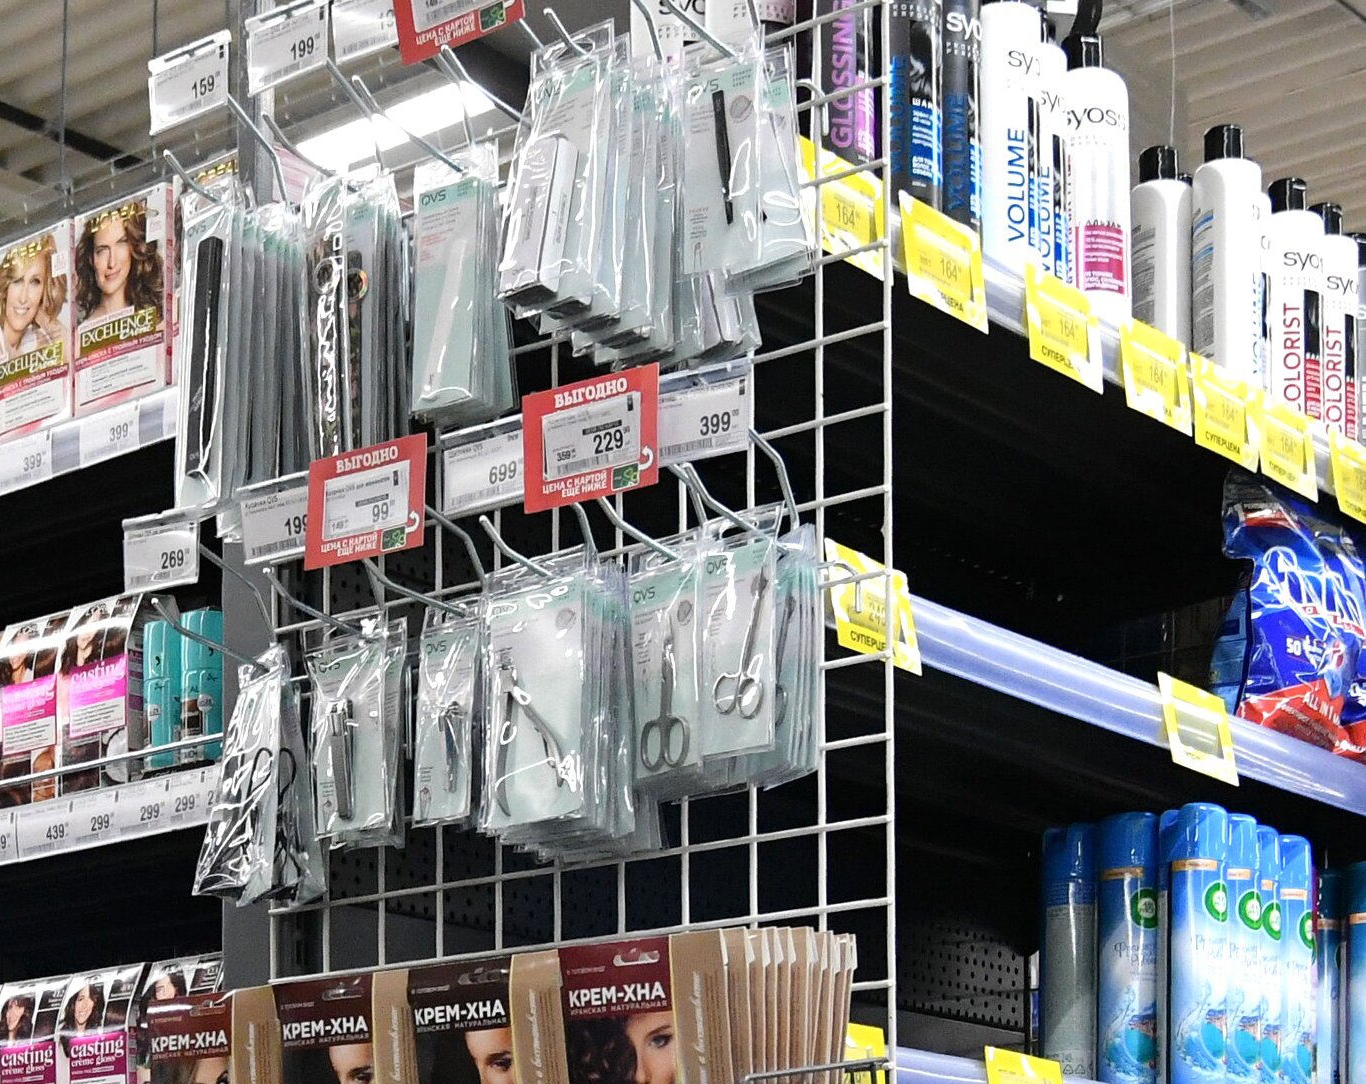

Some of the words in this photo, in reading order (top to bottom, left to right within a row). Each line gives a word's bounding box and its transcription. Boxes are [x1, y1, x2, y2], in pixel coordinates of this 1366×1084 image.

[416, 31, 436, 46] ЦЕНА
[446, 14, 475, 36] КАРТОЙ
[453, 22, 476, 40] НИЖЕ
[290, 40, 315, 60] 199
[192, 79, 215, 99] 159
[1007, 128, 1025, 242] VOLUME
[422, 191, 446, 207] QVS
[81, 312, 154, 347] EXCELLENCE
[554, 378, 627, 409] ВЫГОДНО
[109, 424, 128, 441] 399
[700, 412, 731, 436] 399
[593, 430, 624, 455] 229
[1205, 431, 1241, 455] СУПЕРЦЕНА
[23, 452, 42, 471] 399
[336, 446, 398, 474] ВЫГОДНО
[489, 459, 517, 484] 699
[542, 482, 564, 496] ЦЕНА
[574, 470, 608, 487] КАРТОЙ
[581, 480, 608, 496] НИЖЕ
[372, 503, 389, 522] 99
[321, 541, 341, 554] ЦЕНА
[348, 532, 378, 549] КАРТОЙ
[354, 540, 377, 555] НИЖЕ
[161, 549, 185, 570] 269
[633, 586, 656, 603] QVS
[425, 641, 447, 656] QVS
[140, 804, 160, 821] 299
[175, 794, 194, 811] 299
[47, 824, 64, 841] 439
[91, 814, 110, 831] 299
[569, 981, 667, 1008] КРЕМ-ХНА
[414, 999, 506, 1027] КРЕМ-ХНА
[610, 1000, 668, 1014] НАТУРАЛЬНАЯ
[282, 1015, 368, 1041] КРЕМ-ХНА
[71, 1034, 124, 1059] casting
[151, 1032, 228, 1054] КРЕМ-ХНА
[1, 1044, 54, 1068] casting
[95, 1053, 116, 1067] gloss
[25, 1062, 45, 1076] gloss
